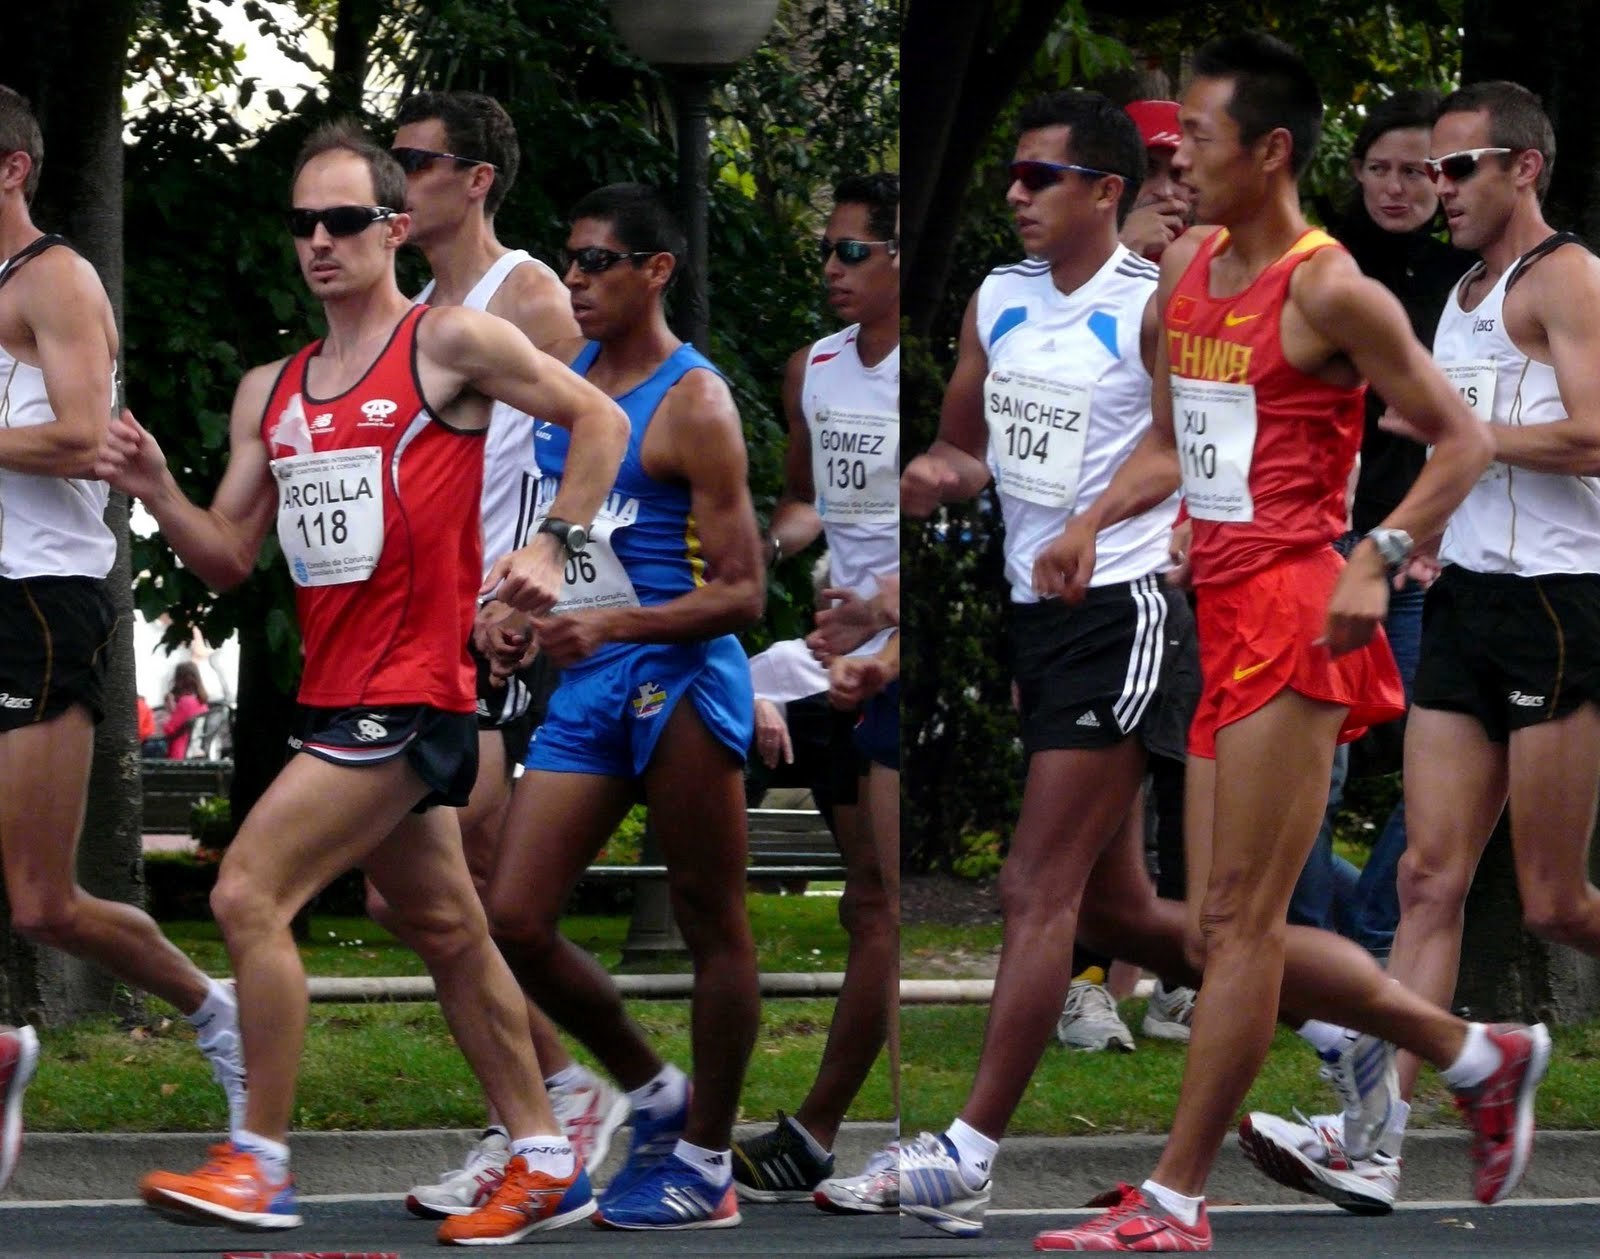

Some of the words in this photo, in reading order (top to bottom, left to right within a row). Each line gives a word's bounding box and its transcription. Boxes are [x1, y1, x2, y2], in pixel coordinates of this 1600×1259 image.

[990, 392, 1081, 432] SANCHEZ
[1183, 409, 1206, 435] XU
[820, 429, 886, 456] GOMEZ
[1005, 422, 1050, 465] 104
[1182, 442, 1216, 480] 110
[827, 456, 867, 490] 130
[283, 476, 374, 510] ARCILLA
[297, 509, 348, 548] 118
[564, 548, 597, 586] 06
